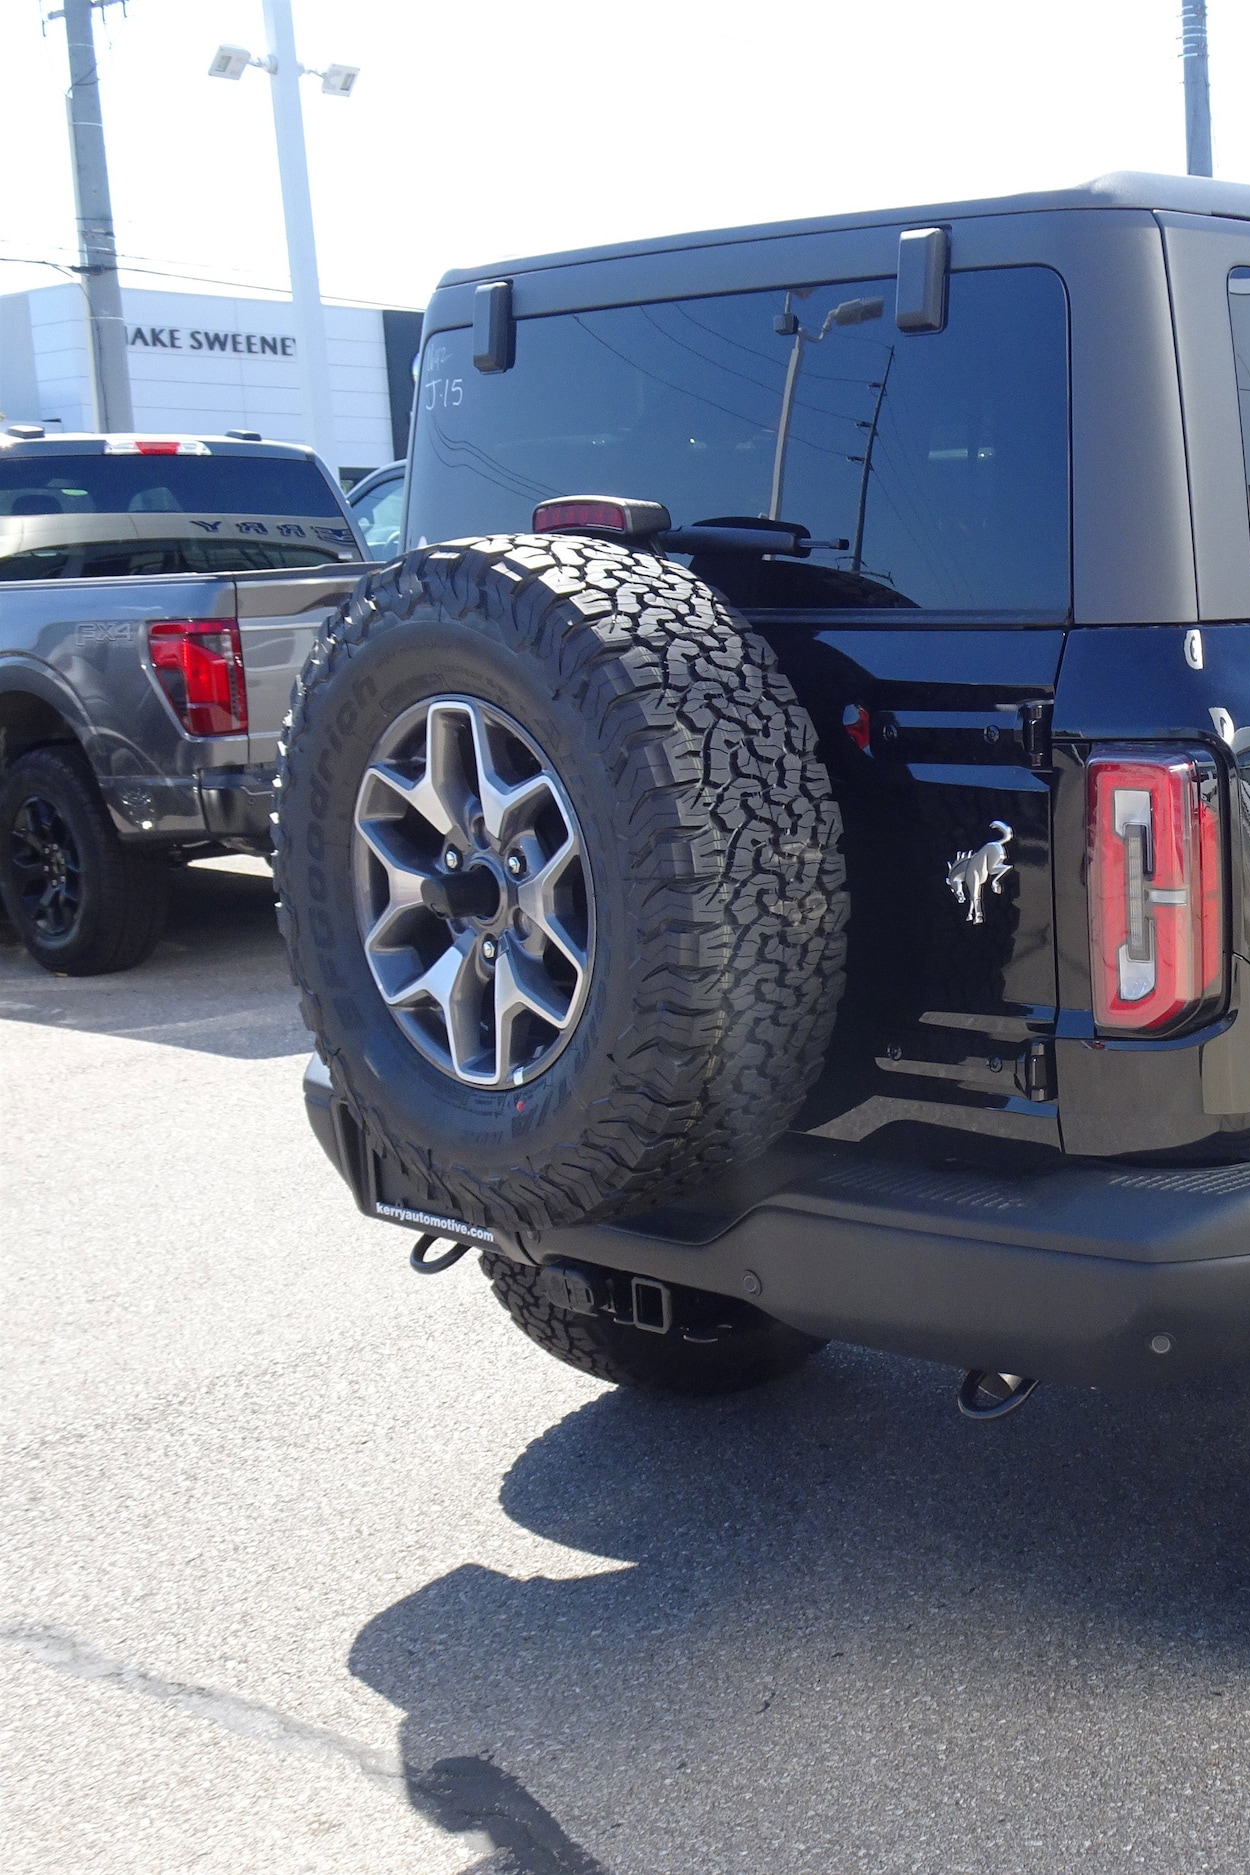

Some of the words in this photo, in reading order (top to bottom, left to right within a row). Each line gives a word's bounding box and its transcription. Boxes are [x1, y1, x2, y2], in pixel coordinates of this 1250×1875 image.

[125, 326, 183, 349] AKE
[190, 330, 297, 357] SWEENE
[75, 623, 134, 648] FX4
[375, 1201, 495, 1242] kerryautomotive.com
